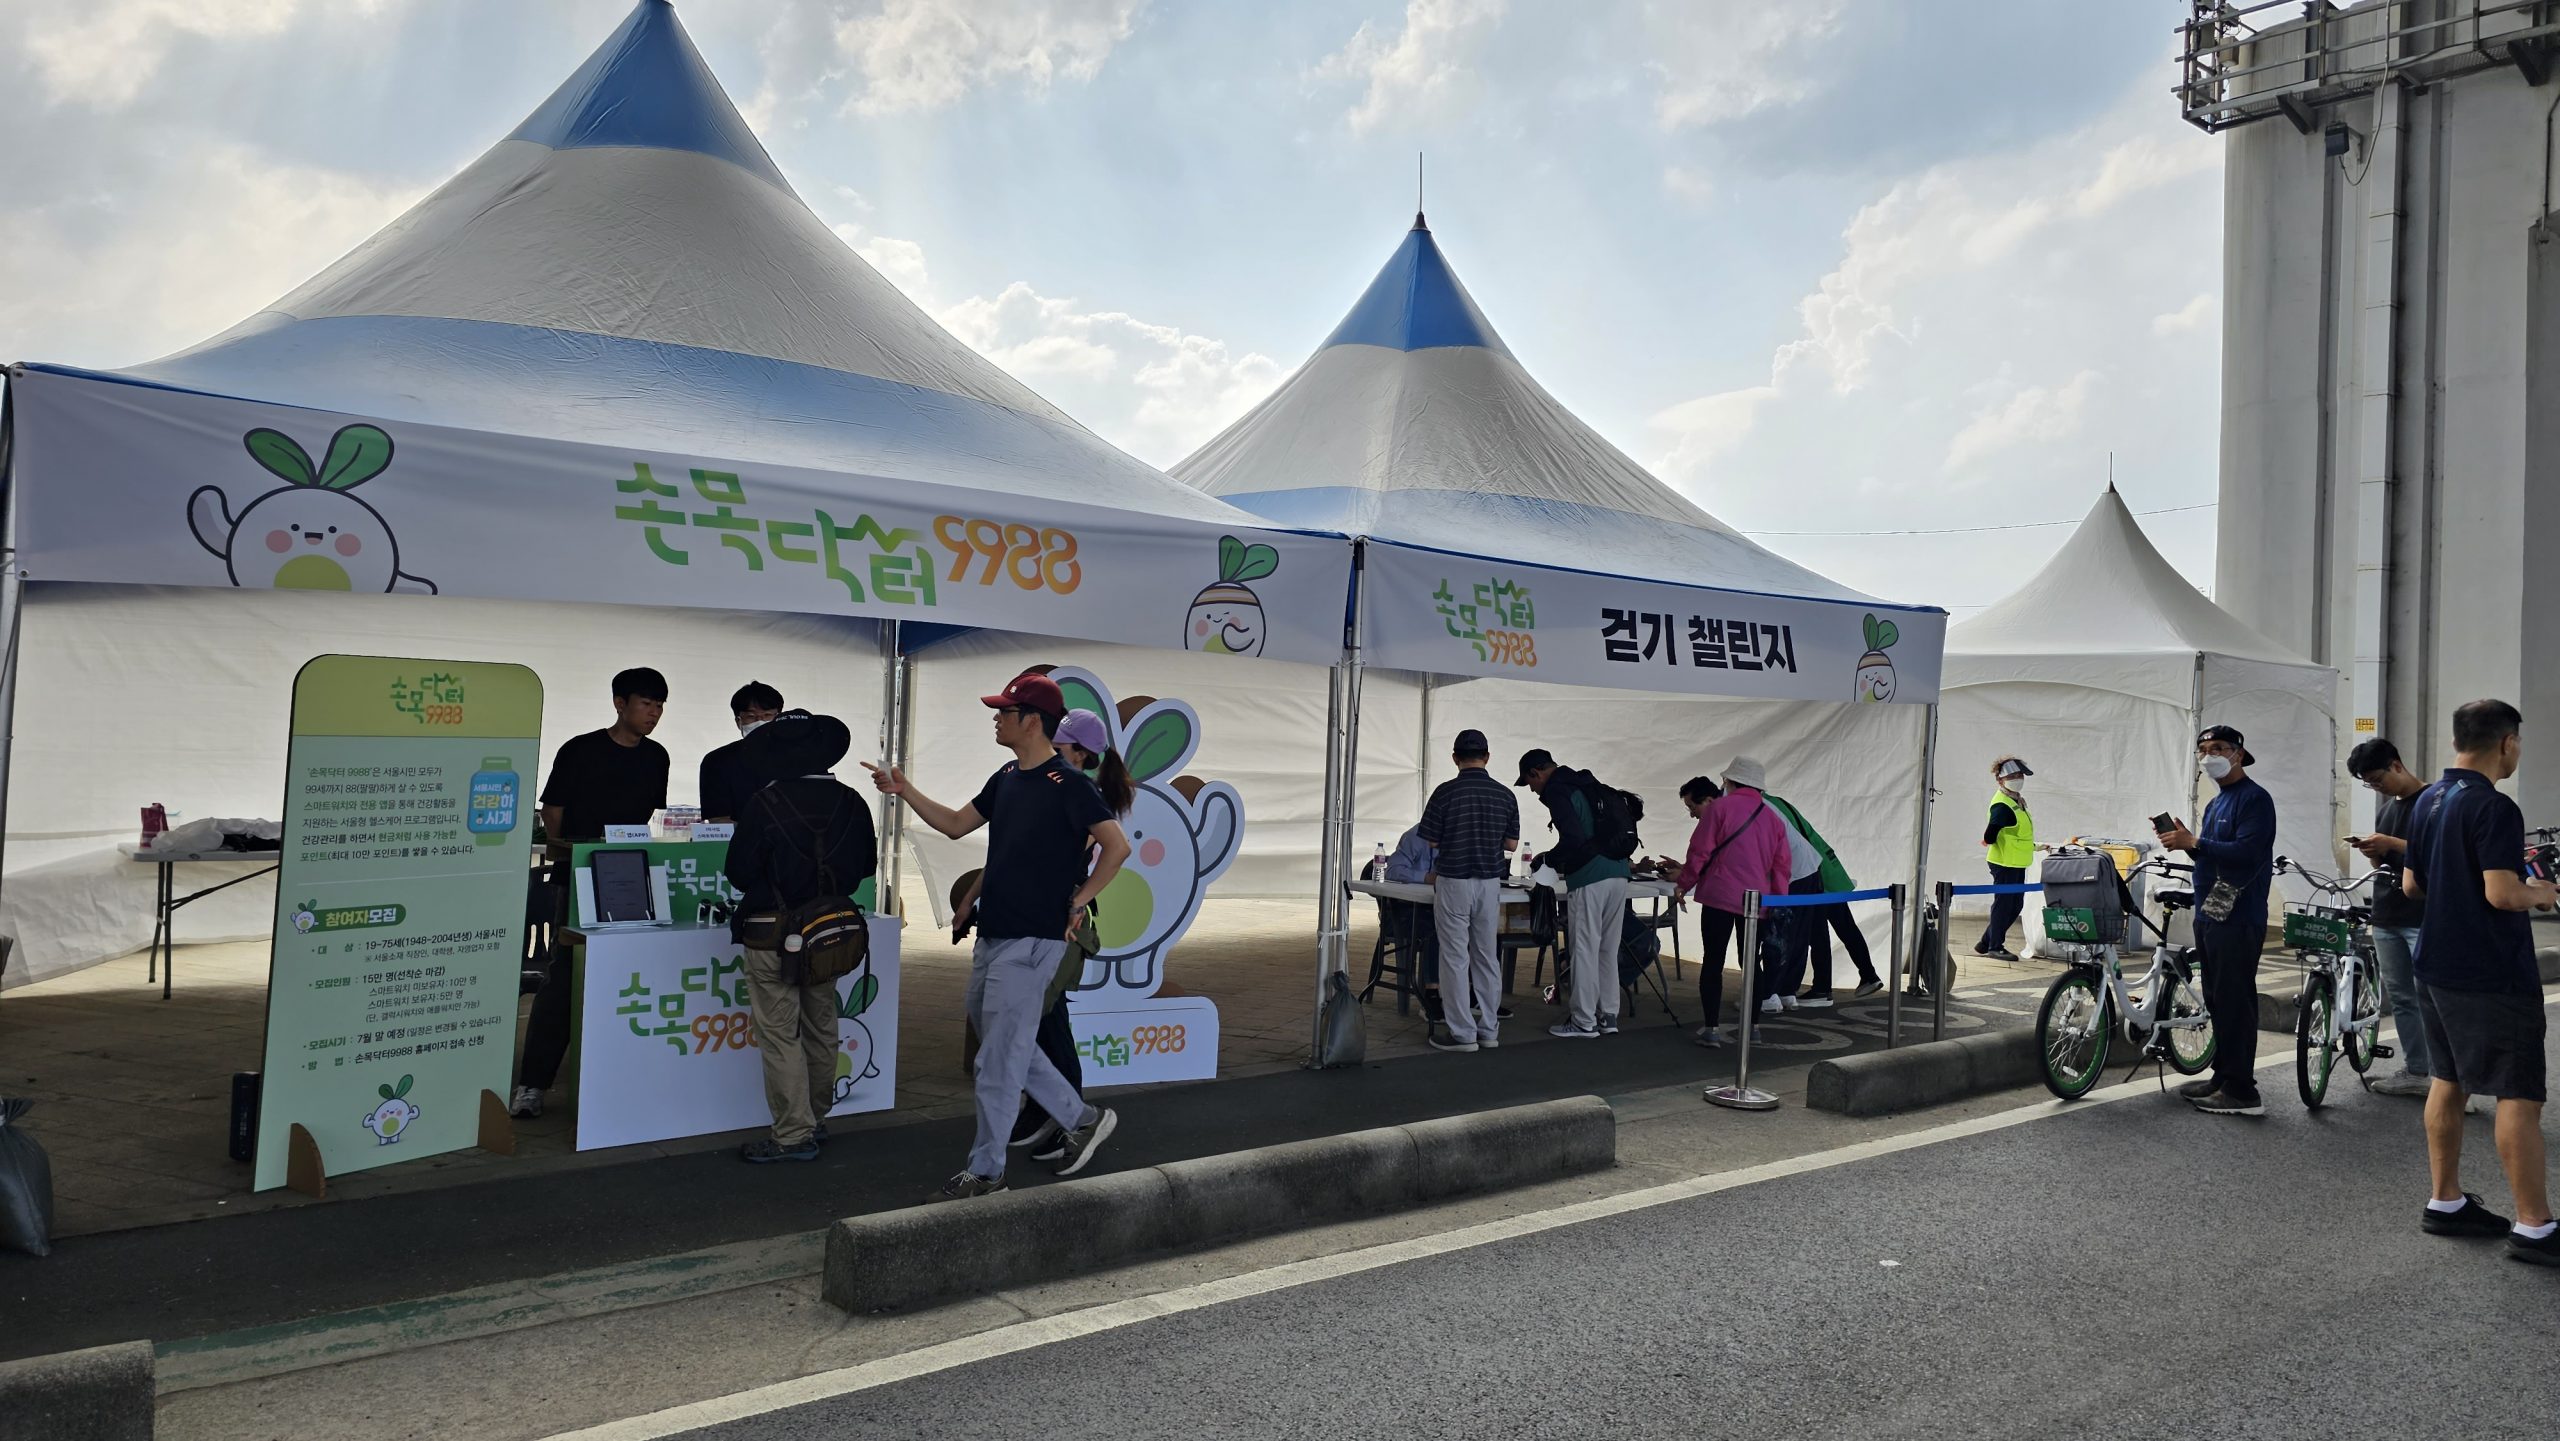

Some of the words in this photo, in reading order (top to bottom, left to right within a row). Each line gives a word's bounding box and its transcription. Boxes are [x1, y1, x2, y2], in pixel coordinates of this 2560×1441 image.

[614, 462, 937, 606] 손목닥터
[932, 514, 1082, 595] 9988
[1433, 576, 1535, 662] 손목닥터
[1486, 628, 1537, 668] 9988
[1601, 607, 1677, 666] 걷기
[1688, 614, 1797, 673] 챌린지
[389, 672, 465, 724] 손목닥터
[426, 704, 463, 725] 9988
[383, 766, 416, 777] 서울시민
[418, 767, 442, 777] 모두가
[305, 783, 343, 795] 99세까지
[398, 783, 406, 793] 살
[408, 783, 417, 793] 수
[419, 782, 443, 793] 있도록
[304, 799, 357, 811] 스마트워치와
[360, 799, 377, 811] 전용
[379, 799, 396, 810] 앱을
[398, 799, 415, 810] 통해
[417, 798, 456, 809] 건강활동을
[473, 793, 514, 809] 건강하
[302, 817, 338, 829] 지원하는
[340, 816, 367, 828] 서울형
[369, 815, 402, 827] 헬스케어
[404, 813, 462, 825] 프로그램입니다.
[485, 810, 512, 825] 시계
[302, 833, 347, 846] 건강관리를
[349, 832, 376, 844] 하면서
[378, 830, 412, 843] 현금처럼
[414, 830, 431, 841] 사용
[432, 829, 457, 841] 가능한
[299, 849, 349, 862] 포인트(최대
[352, 848, 370, 860] 10만
[372, 847, 410, 859] 포인트)를
[412, 846, 428, 857] 쌓을
[430, 846, 439, 856] 수
[441, 844, 475, 856] 있습니다.
[474, 927, 507, 940] 서울시민
[374, 951, 404, 963] 서울소재
[314, 976, 351, 990] 모집인원
[362, 972, 383, 984] 15만
[385, 967, 423, 983] 명(선착순
[425, 965, 446, 978] 마감)
[368, 982, 411, 997] 스마트워치
[469, 975, 477, 986] 명
[367, 996, 410, 1010] 스마트워치
[455, 989, 464, 1000] 명
[308, 1036, 347, 1051] 모집시기
[357, 1032, 372, 1044] 7월
[374, 1030, 384, 1042] 말
[386, 1026, 405, 1039] 예정
[406, 1024, 433, 1038] (일정은
[459, 1020, 467, 1030] 수
[468, 1015, 502, 1028] 있습니다)
[1131, 1023, 1186, 1055] 9988
[354, 1046, 414, 1065] 손목닥터9988
[415, 1040, 448, 1055] 홈페이지
[449, 1037, 466, 1050] 접속
[467, 1034, 485, 1047] 신청
